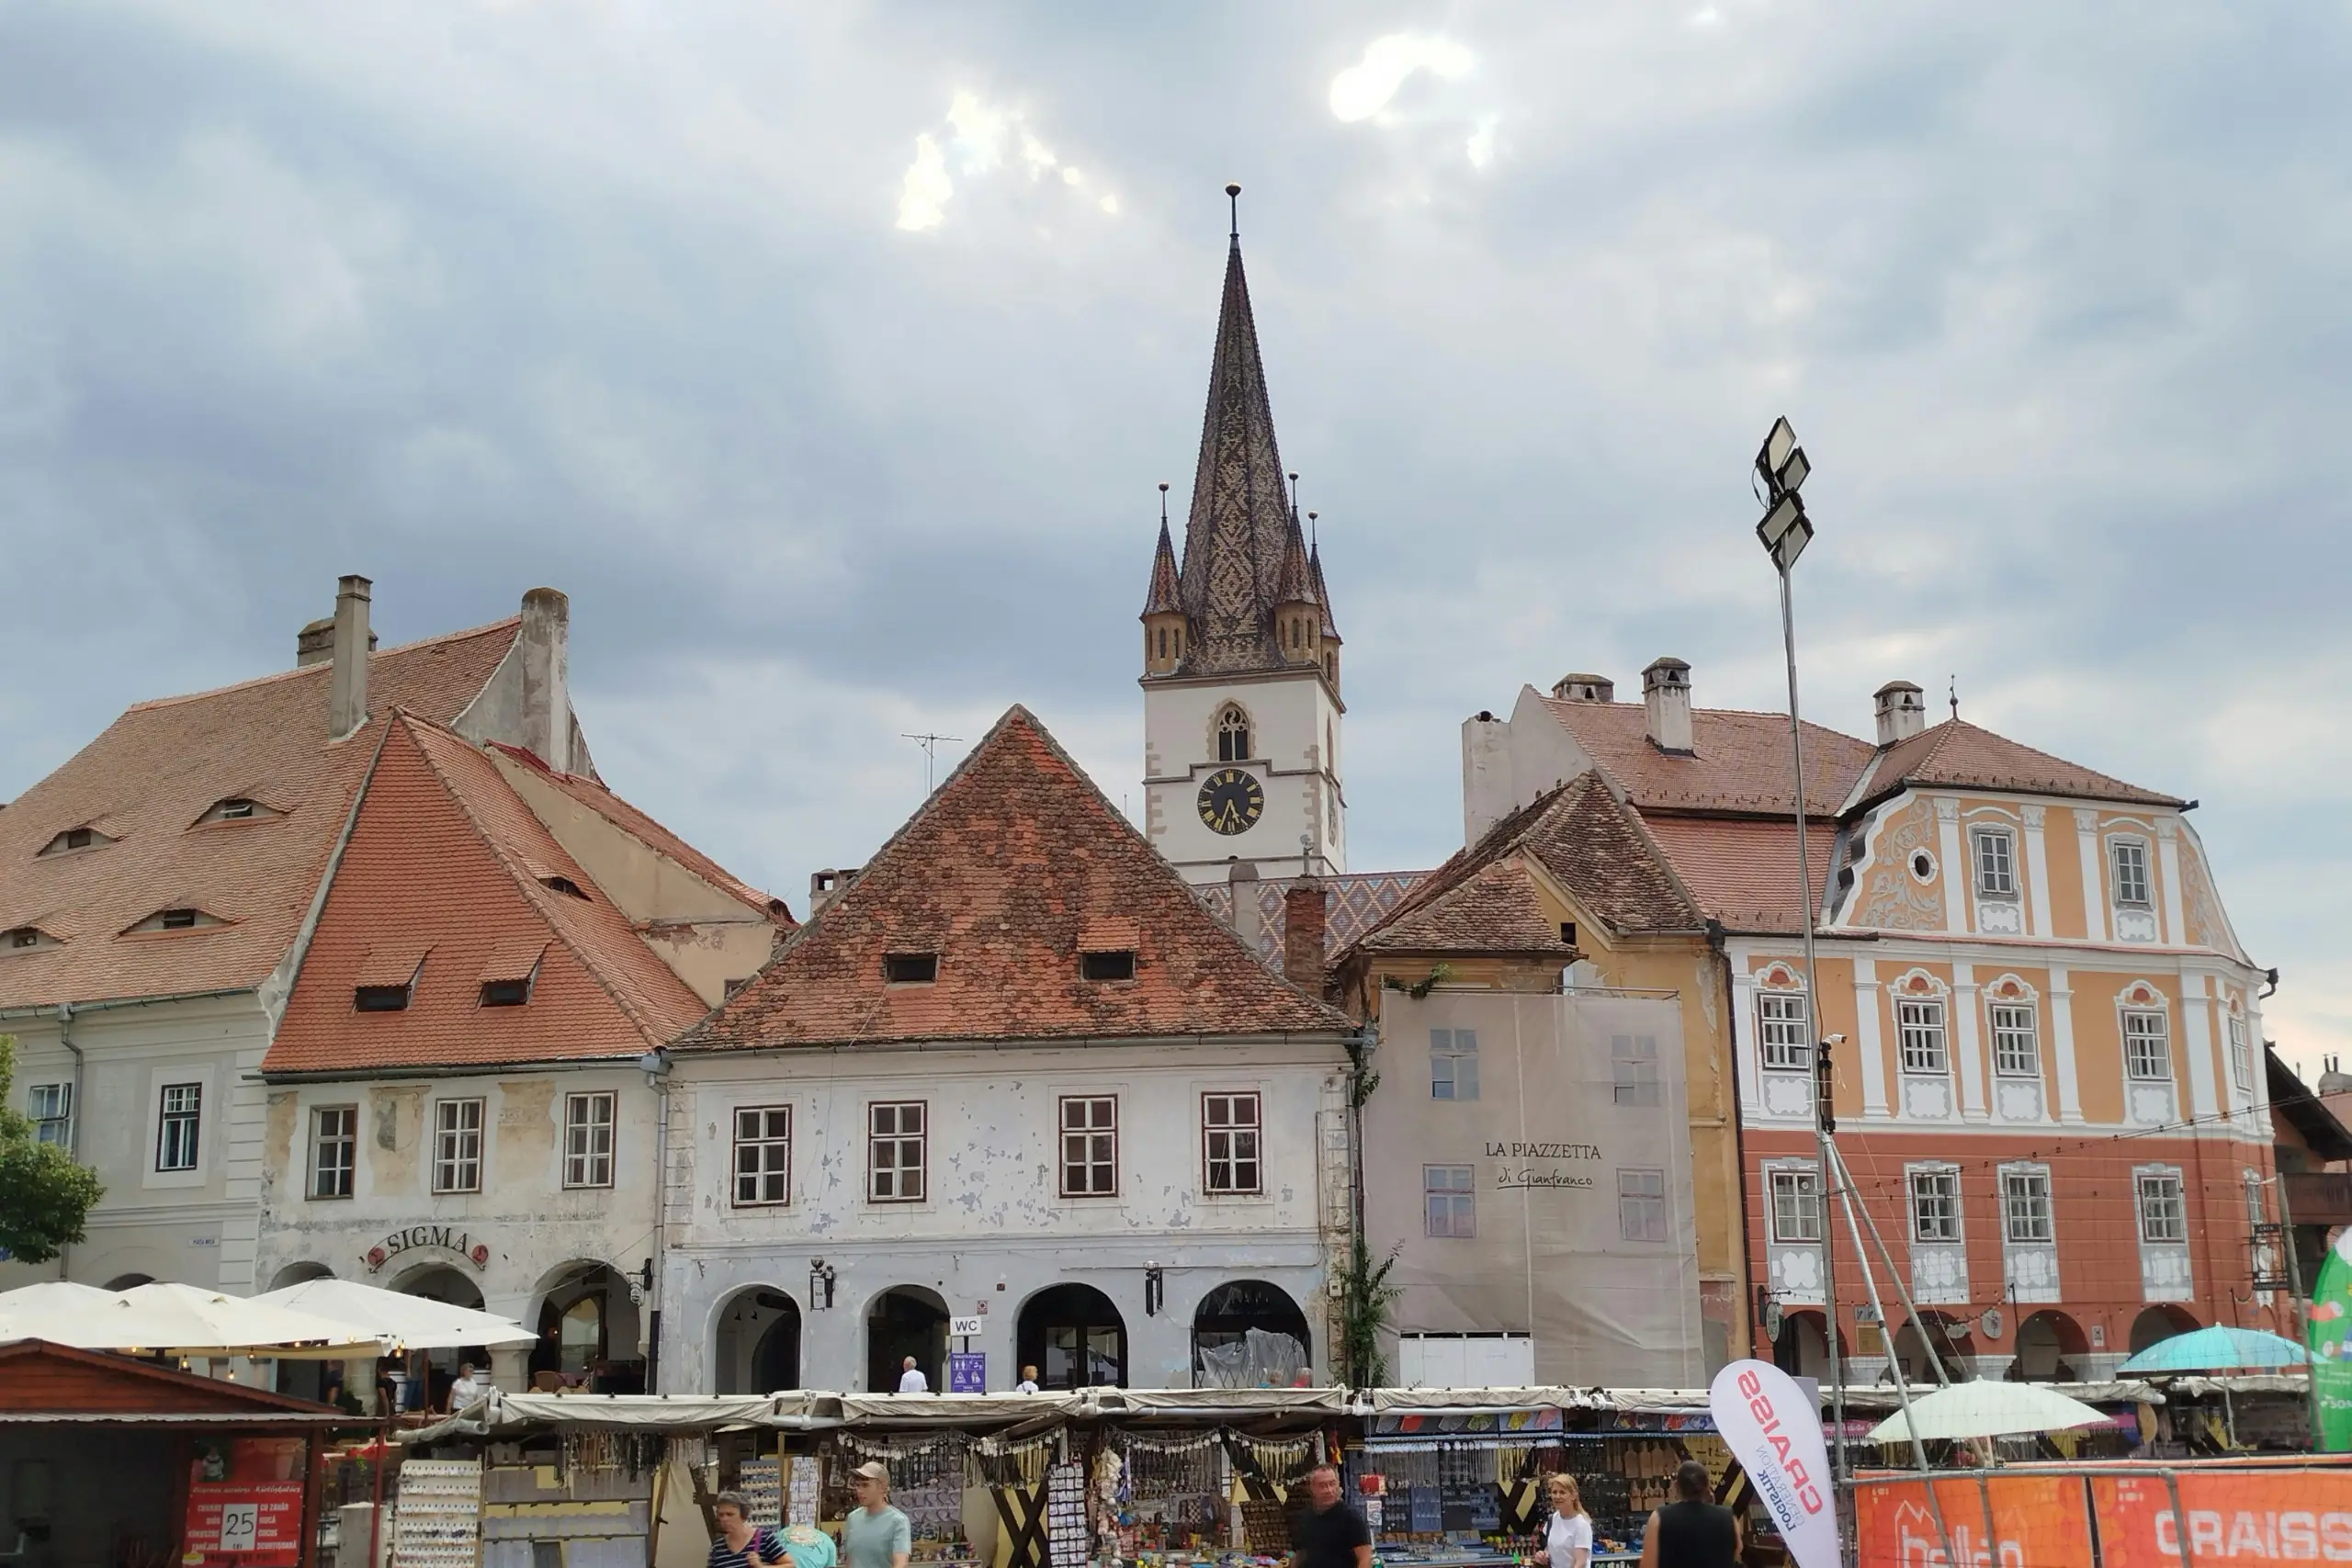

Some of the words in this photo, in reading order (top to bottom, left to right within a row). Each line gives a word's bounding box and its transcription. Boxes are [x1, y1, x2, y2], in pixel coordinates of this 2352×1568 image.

[1485, 1142, 1508, 1157] LA
[1511, 1143, 1602, 1159] PIAZZETTA
[1498, 1167, 1511, 1184] di
[1517, 1168, 1593, 1191] Gianfranco
[387, 1225, 468, 1255] SIGMA
[955, 1320, 978, 1332] WC
[225, 1512, 254, 1537] 25
[2154, 1509, 2352, 1562] CRAISS
